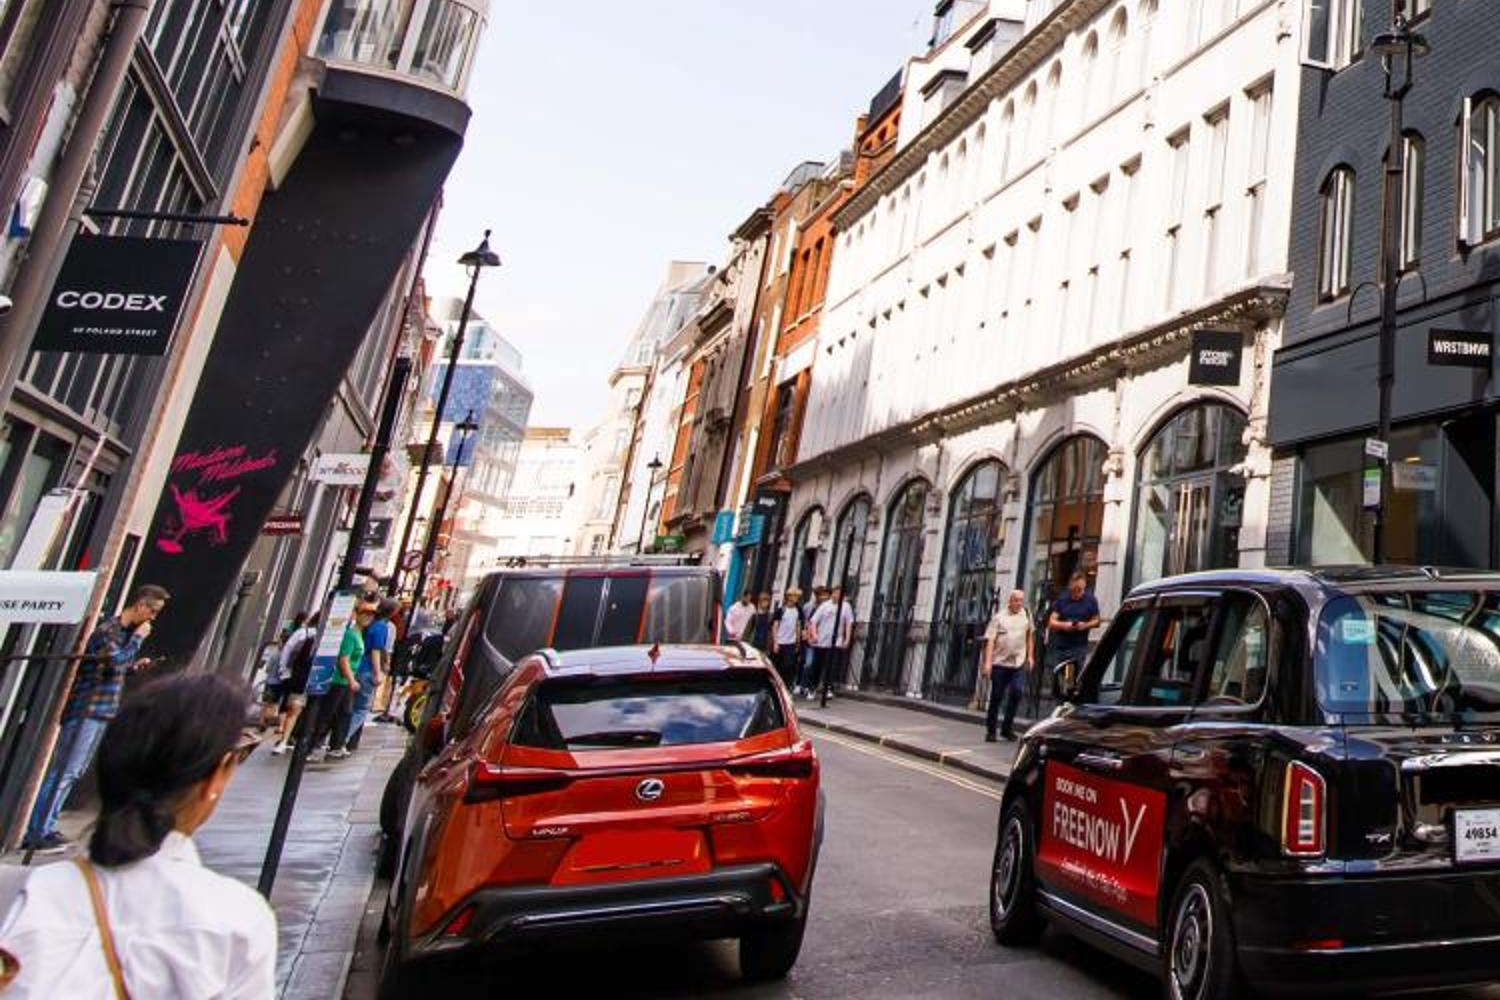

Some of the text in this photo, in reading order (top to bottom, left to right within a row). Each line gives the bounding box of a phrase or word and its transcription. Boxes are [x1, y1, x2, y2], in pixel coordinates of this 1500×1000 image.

[57, 291, 168, 311] CODEX
[21, 600, 65, 611] PARTY
[1053, 802, 1121, 863] FREENOW
[1364, 833, 1391, 843] TX
[1465, 827, 1498, 840] 49854
